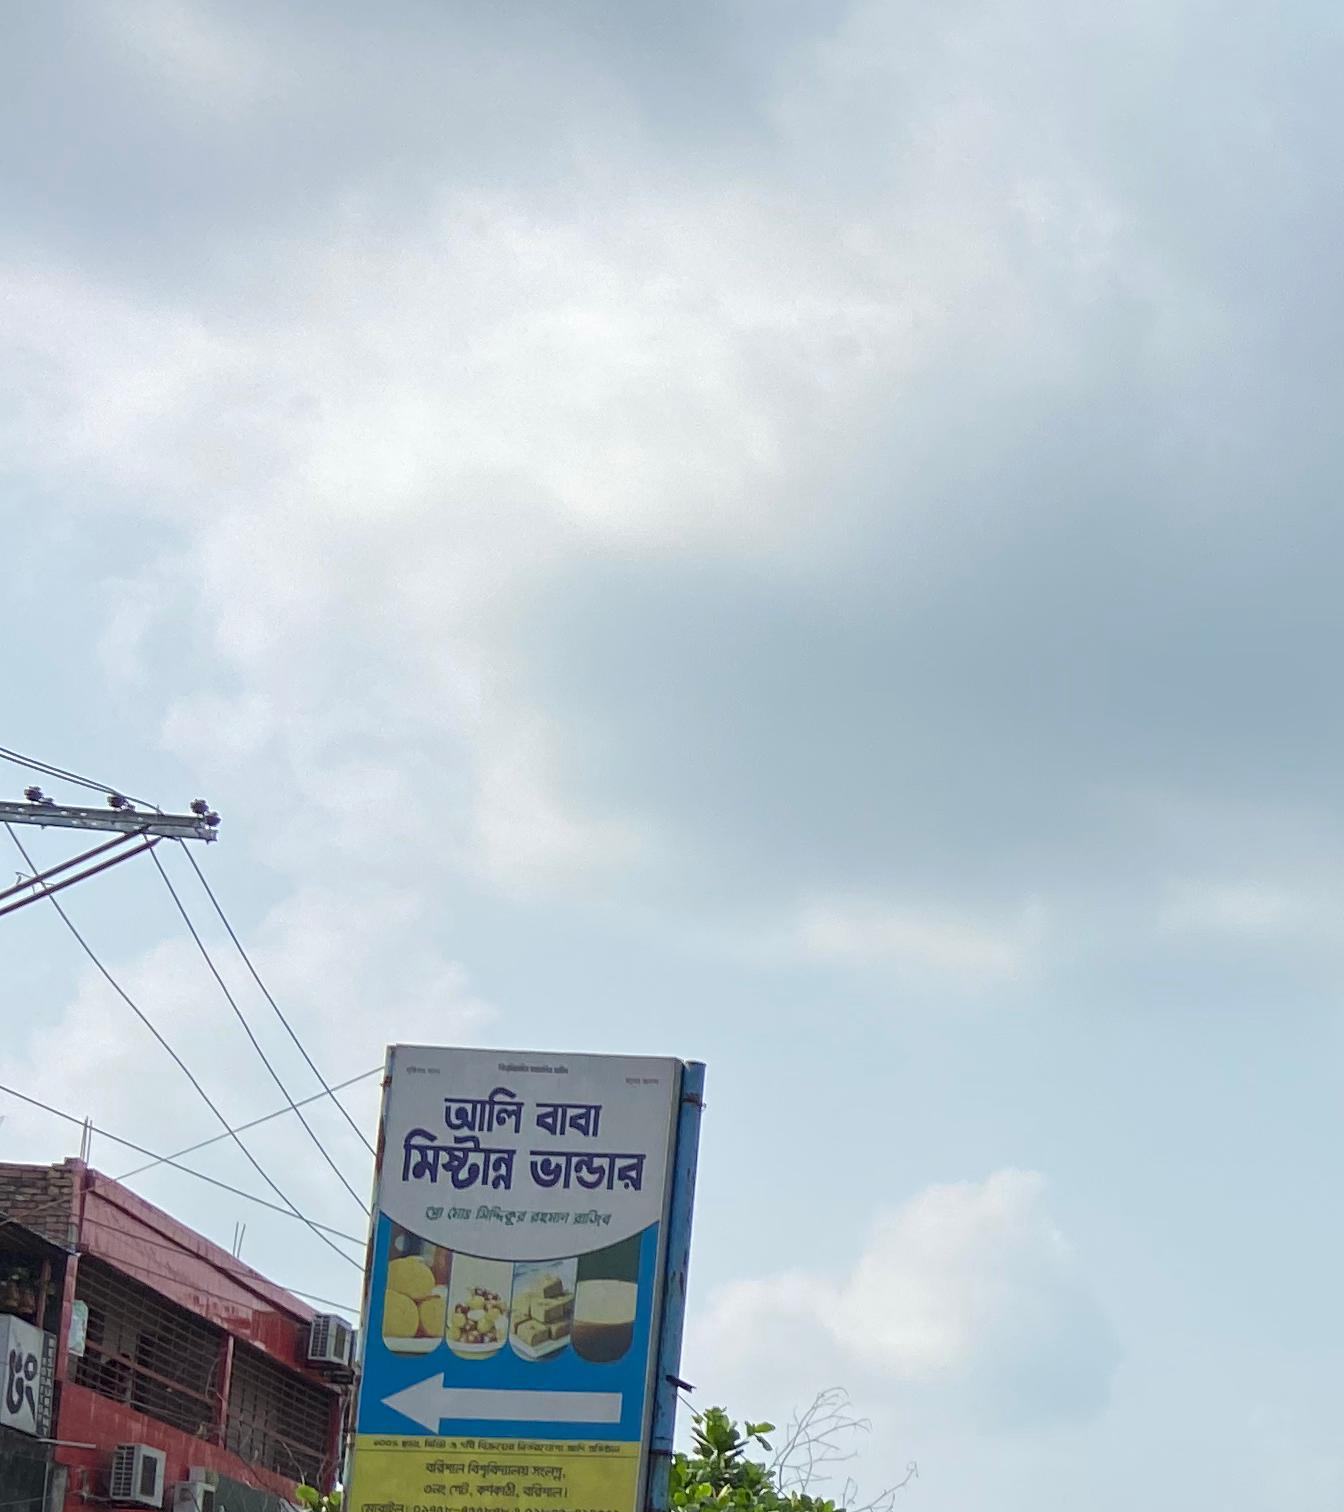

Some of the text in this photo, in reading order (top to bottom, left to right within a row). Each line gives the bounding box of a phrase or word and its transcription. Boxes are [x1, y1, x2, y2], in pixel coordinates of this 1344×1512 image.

[444, 1087, 602, 1137] আলি বাবা
[402, 1128, 646, 1191] মিষ্টান্ন ভান্ডার
[425, 1459, 465, 1474] বরিশাল
